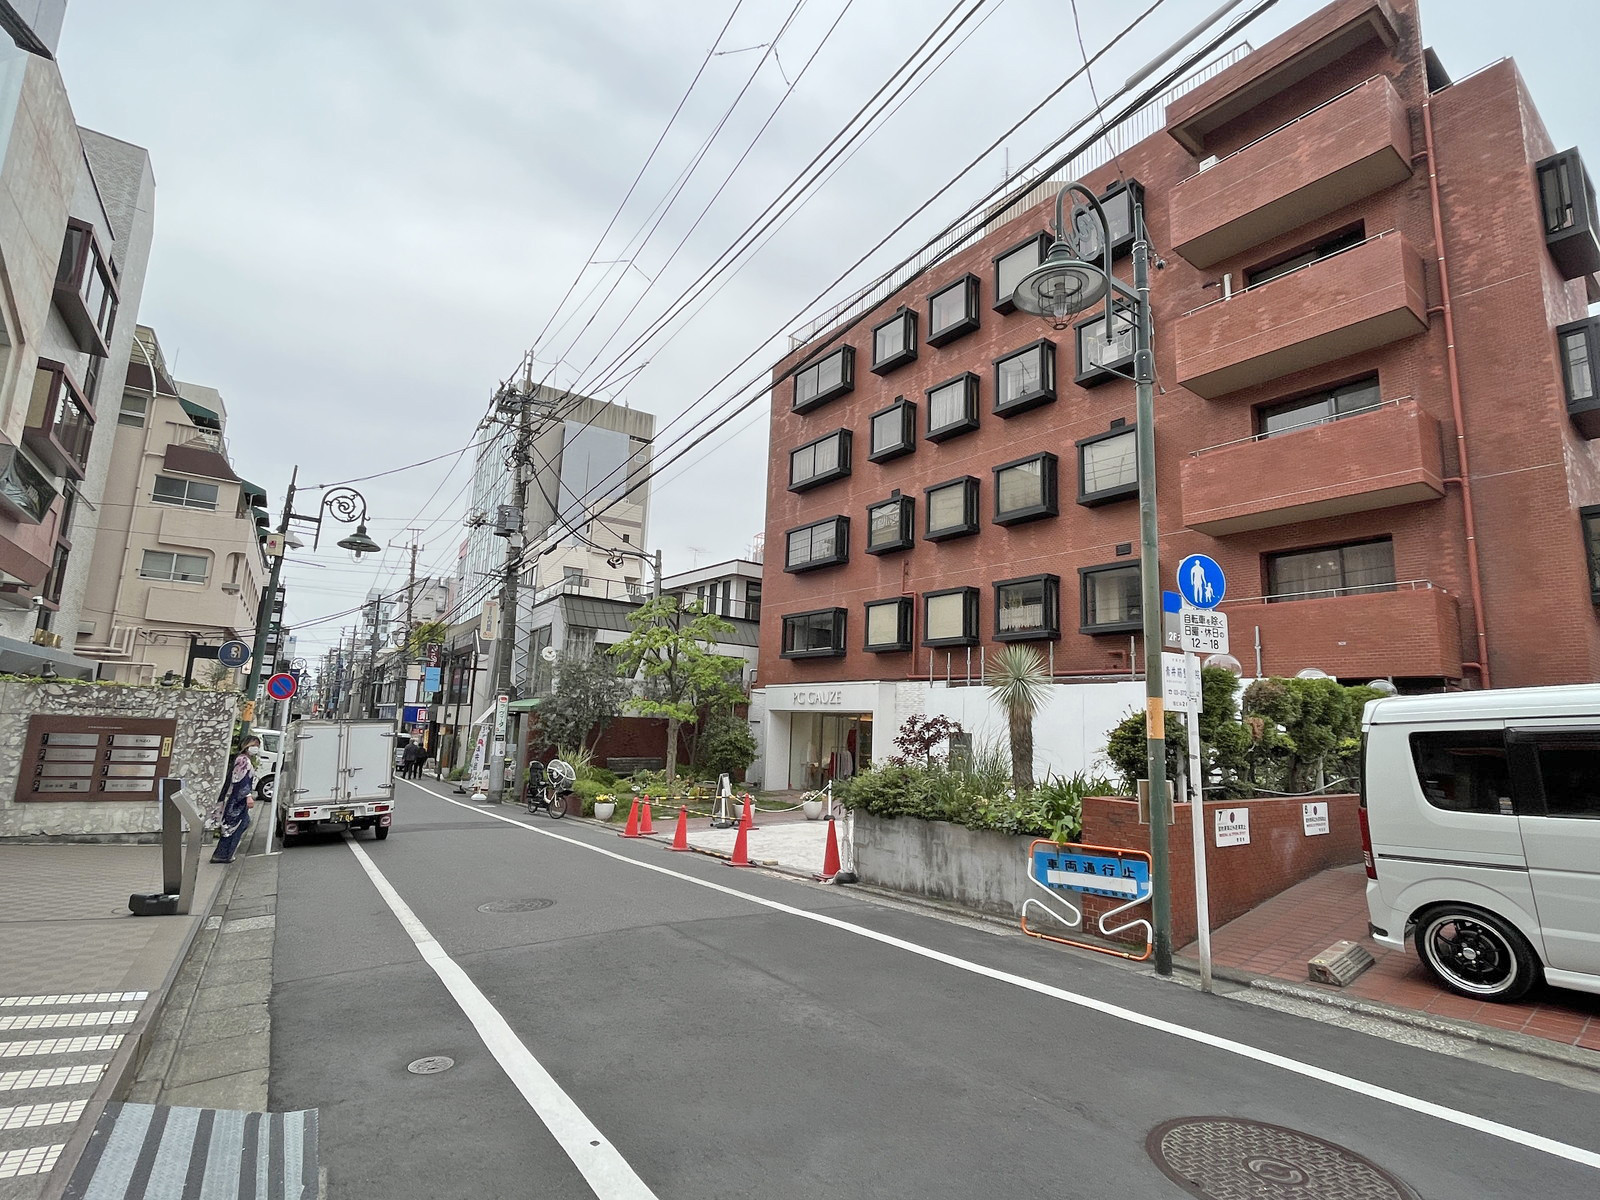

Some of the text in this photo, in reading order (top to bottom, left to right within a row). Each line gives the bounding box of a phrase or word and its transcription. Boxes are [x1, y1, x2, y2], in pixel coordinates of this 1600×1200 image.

[1184, 613, 1223, 626] 自転車を除く
[1184, 626, 1225, 638] 日曜・休日の
[1046, 857, 1137, 880] 車両通行止
